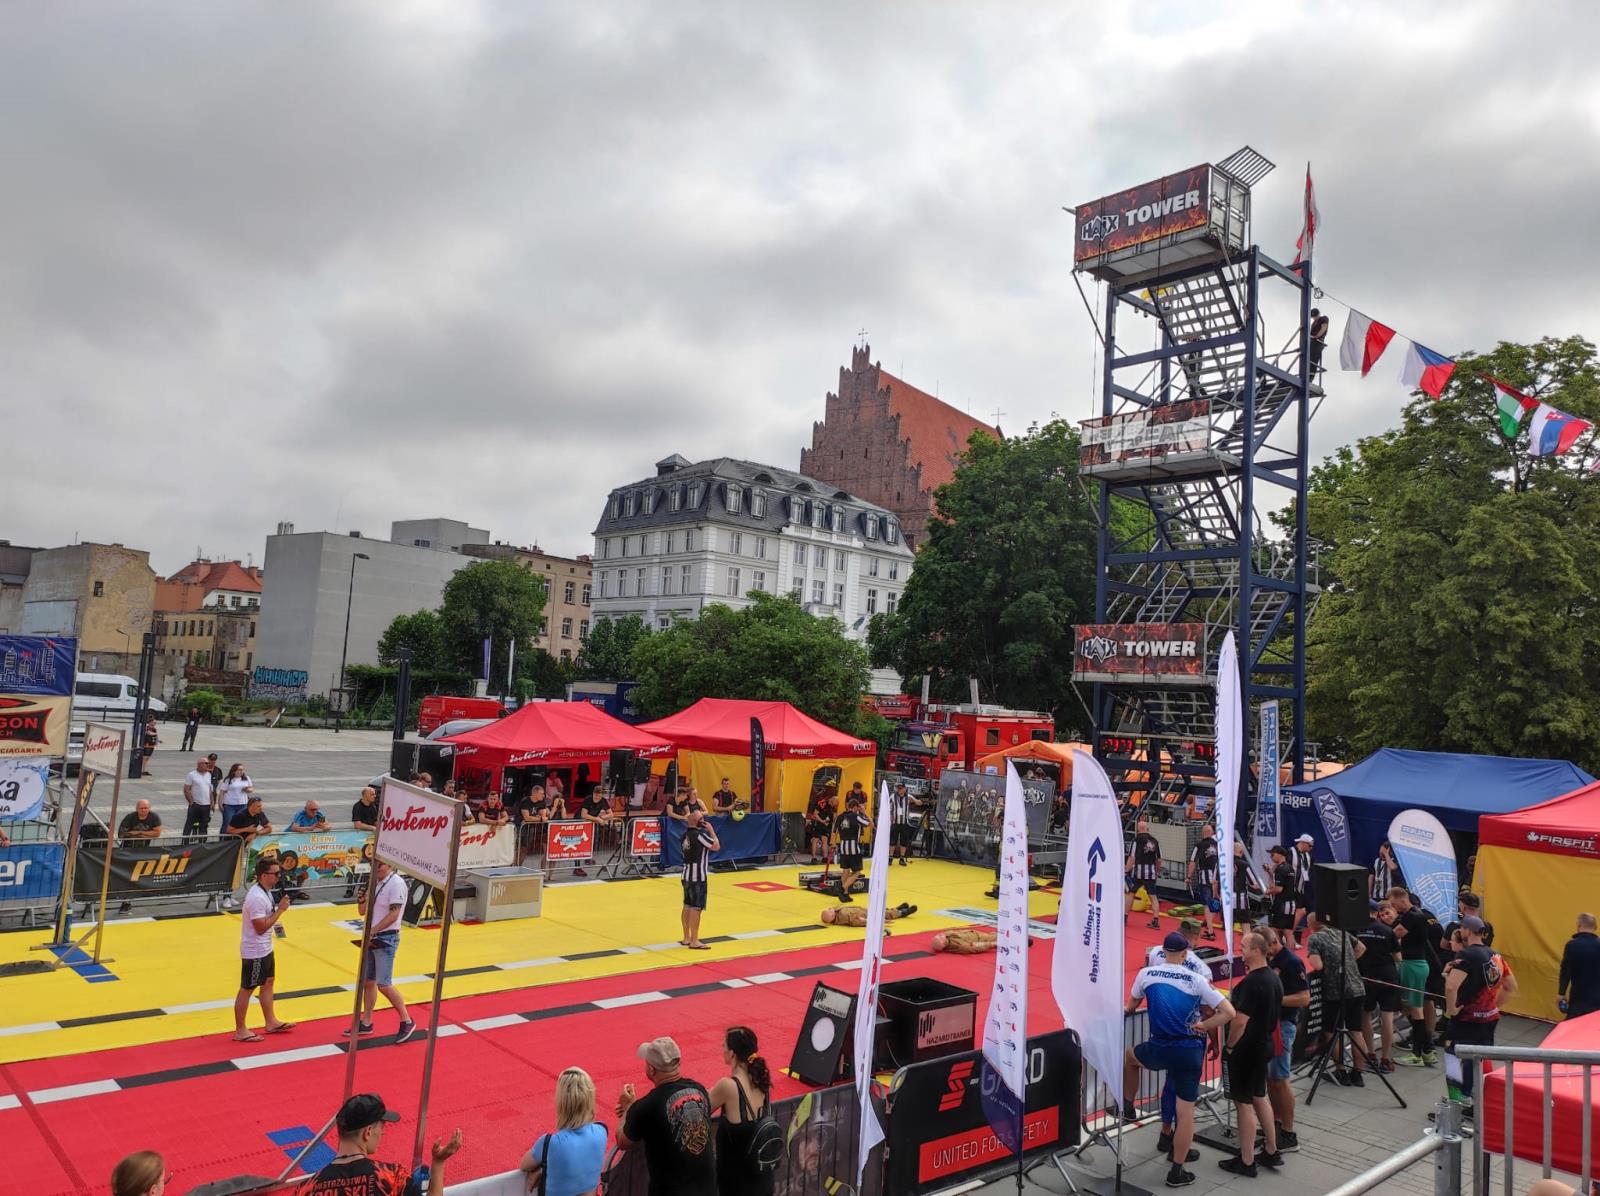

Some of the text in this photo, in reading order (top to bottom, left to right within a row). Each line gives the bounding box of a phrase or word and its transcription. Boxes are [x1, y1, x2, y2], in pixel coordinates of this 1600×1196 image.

[1125, 189, 1199, 227] TOWER
[1124, 640, 1196, 657] TOWER
[1280, 791, 1312, 808] räger
[382, 805, 448, 837] isotemp
[1540, 835, 1595, 850] FIREFIT
[130, 849, 193, 882] pbi
[1147, 970, 1193, 982] POMORSKIE
[932, 1140, 978, 1169] UNITED
